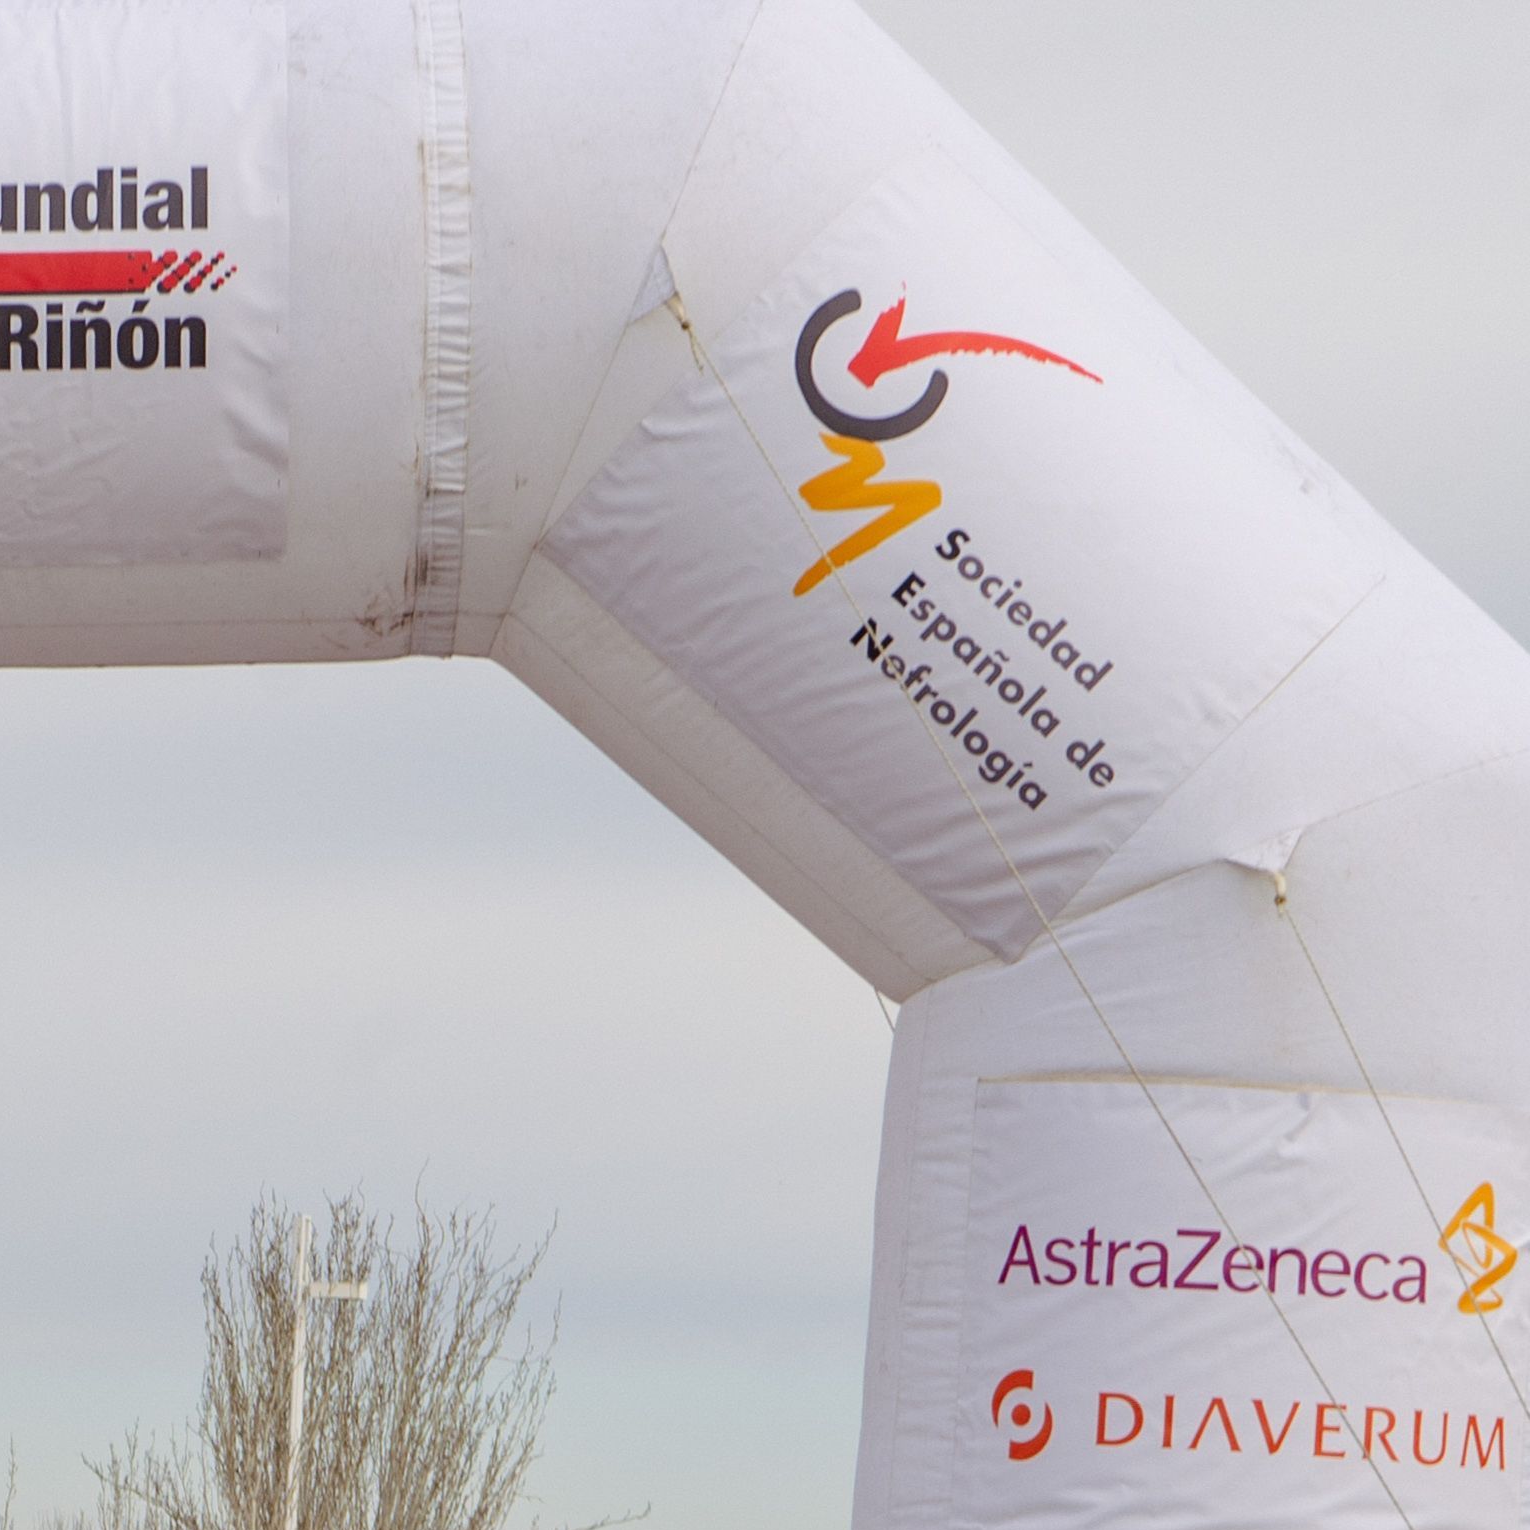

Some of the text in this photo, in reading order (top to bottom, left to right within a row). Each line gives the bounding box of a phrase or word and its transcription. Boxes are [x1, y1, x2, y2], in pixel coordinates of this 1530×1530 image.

[891, 571, 1116, 788] Española de
[935, 528, 1114, 692] Sociedad
[850, 618, 1049, 811] Nefrología
[997, 1224, 1427, 1304] AstraZeneca
[1095, 1391, 1506, 1471] DIAVERUM
